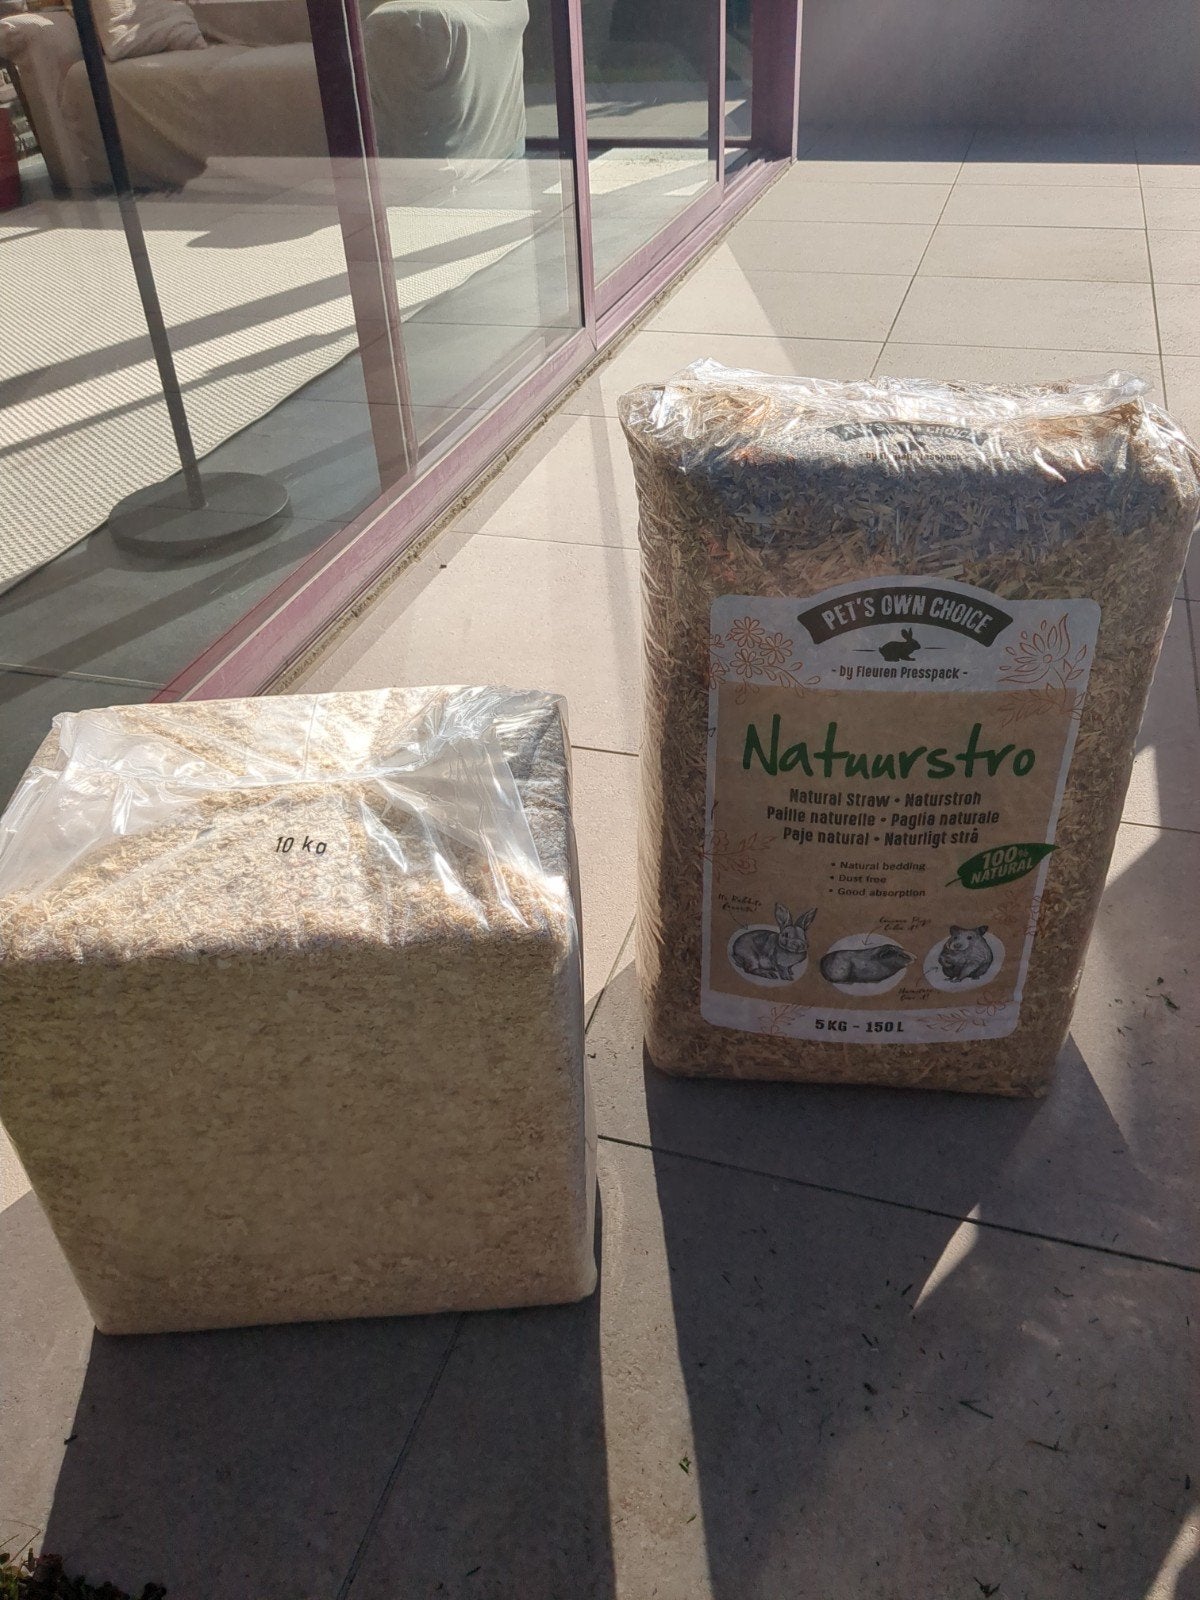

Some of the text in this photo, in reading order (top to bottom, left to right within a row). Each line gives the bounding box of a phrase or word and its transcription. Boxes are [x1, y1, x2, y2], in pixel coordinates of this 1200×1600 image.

[821, 594, 994, 634] PET'S OWN CHOICE
[839, 665, 960, 682] by Fleuren Presspack
[742, 713, 1036, 780] Natuurstro
[789, 788, 982, 808] Natural Straw Naturstroh
[767, 806, 1000, 831] Paille naturelle Paglia naturale
[275, 836, 295, 853] 10
[783, 826, 979, 848] Paje natural Naturligt strå
[840, 861, 926, 872] Natural bedding
[970, 857, 1033, 884] NATURAL
[838, 874, 887, 884] Dust free
[837, 887, 926, 899] Good absorption
